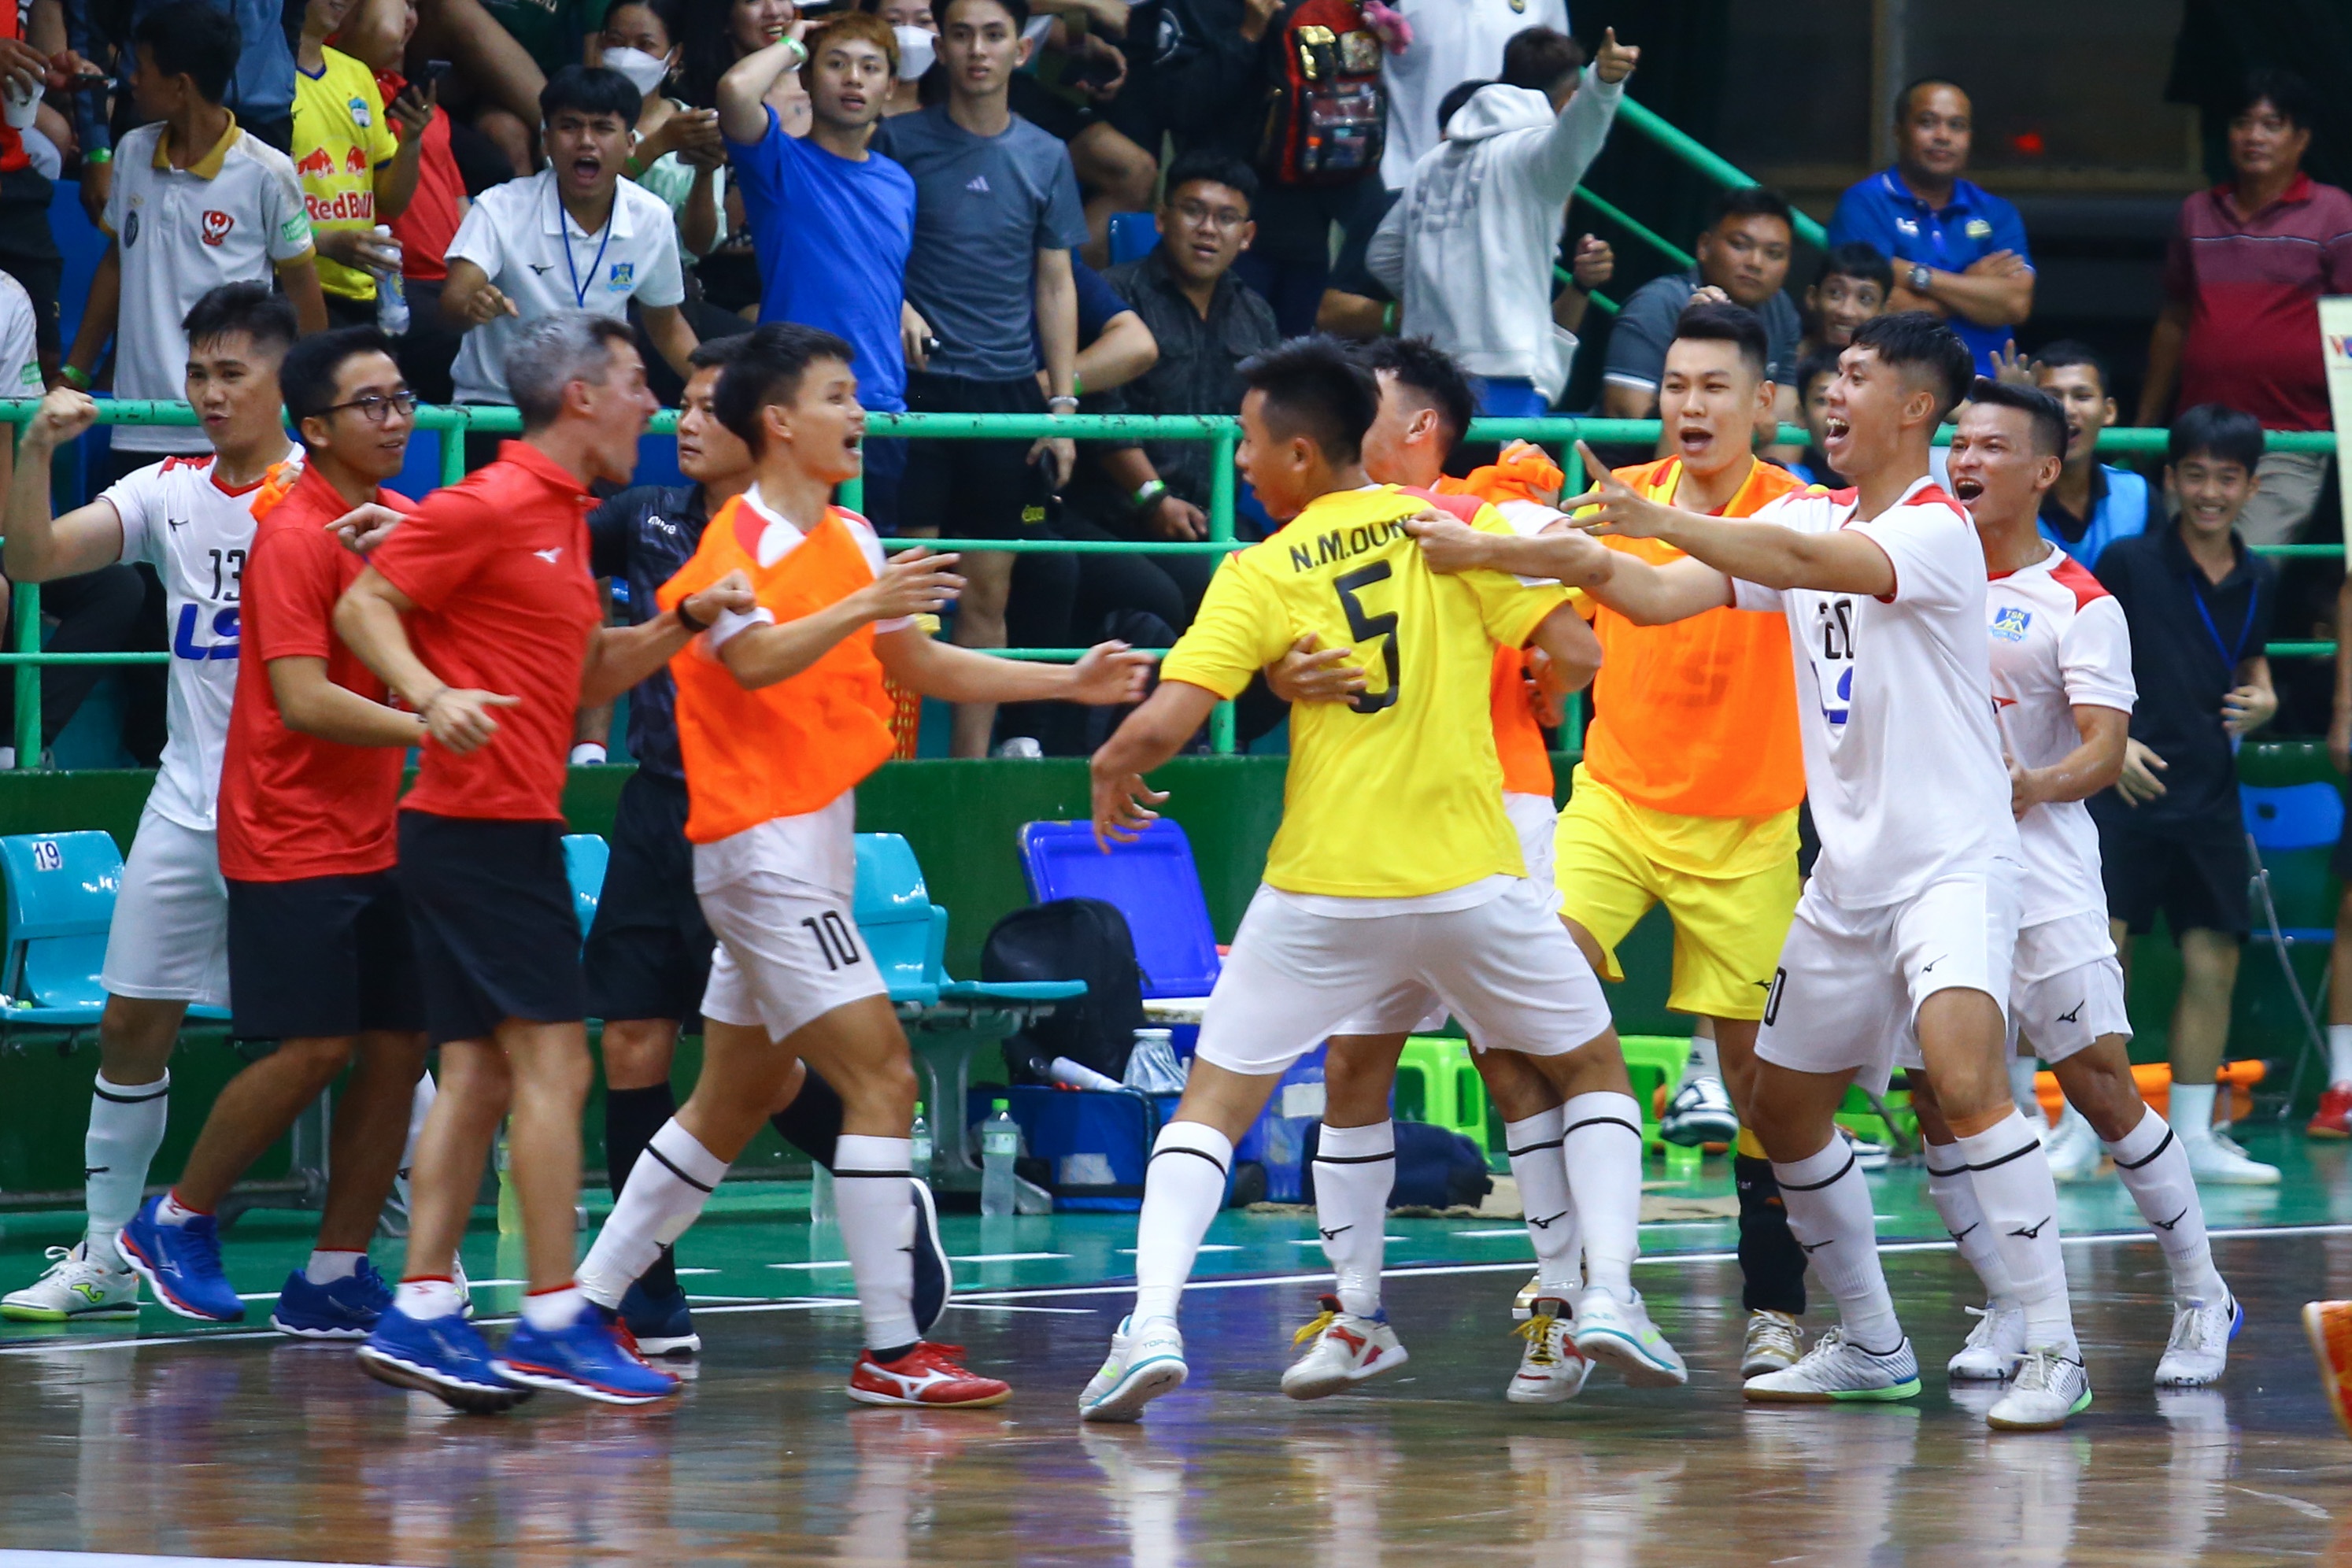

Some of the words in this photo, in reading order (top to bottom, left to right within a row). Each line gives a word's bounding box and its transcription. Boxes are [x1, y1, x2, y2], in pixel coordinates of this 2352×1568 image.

[209, 549, 246, 601] 13
[1332, 559, 1400, 714] 5
[35, 842, 60, 869] 19
[801, 910, 860, 971] 10
